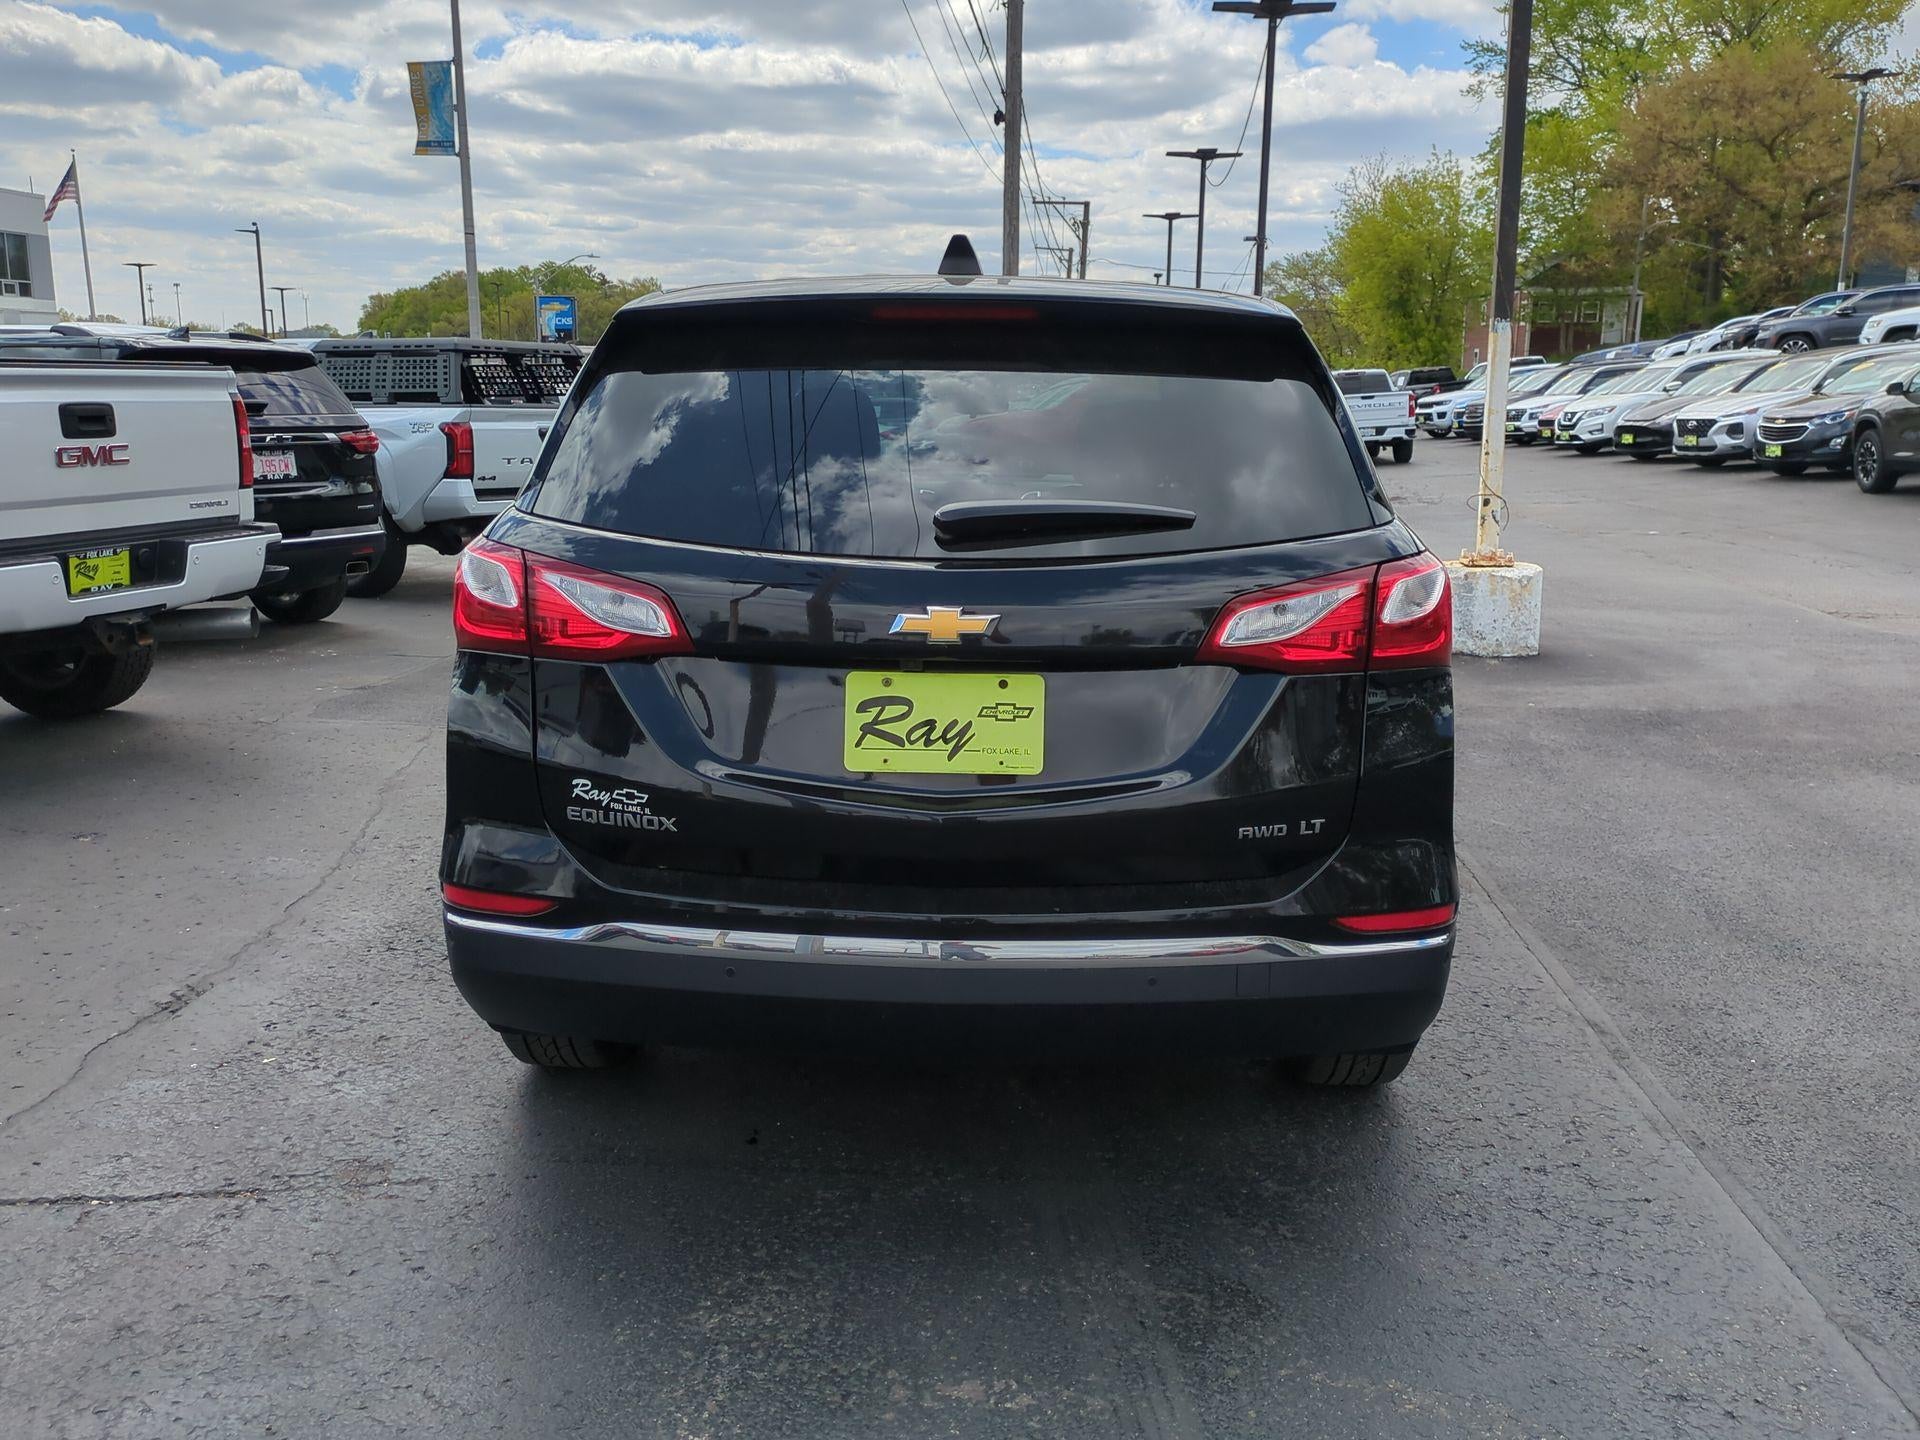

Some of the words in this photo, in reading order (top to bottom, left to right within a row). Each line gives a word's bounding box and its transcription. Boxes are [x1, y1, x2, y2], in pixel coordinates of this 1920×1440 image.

[1348, 401, 1404, 409] EVROLET
[55, 443, 130, 468] GMC
[260, 459, 277, 473] 195
[99, 549, 114, 557] LAKE
[74, 561, 100, 581] Ray
[855, 696, 975, 762] Ray
[982, 747, 998, 755] FOX
[999, 748, 1022, 756] LAKE,
[1023, 748, 1031, 756] IL
[571, 778, 612, 807] Ray
[610, 802, 623, 810] FOX
[624, 804, 643, 814] LAKE,
[644, 807, 652, 815] IL
[566, 806, 678, 832] EQUINOX
[1238, 824, 1288, 839] AWD
[1300, 819, 1326, 835] LT
